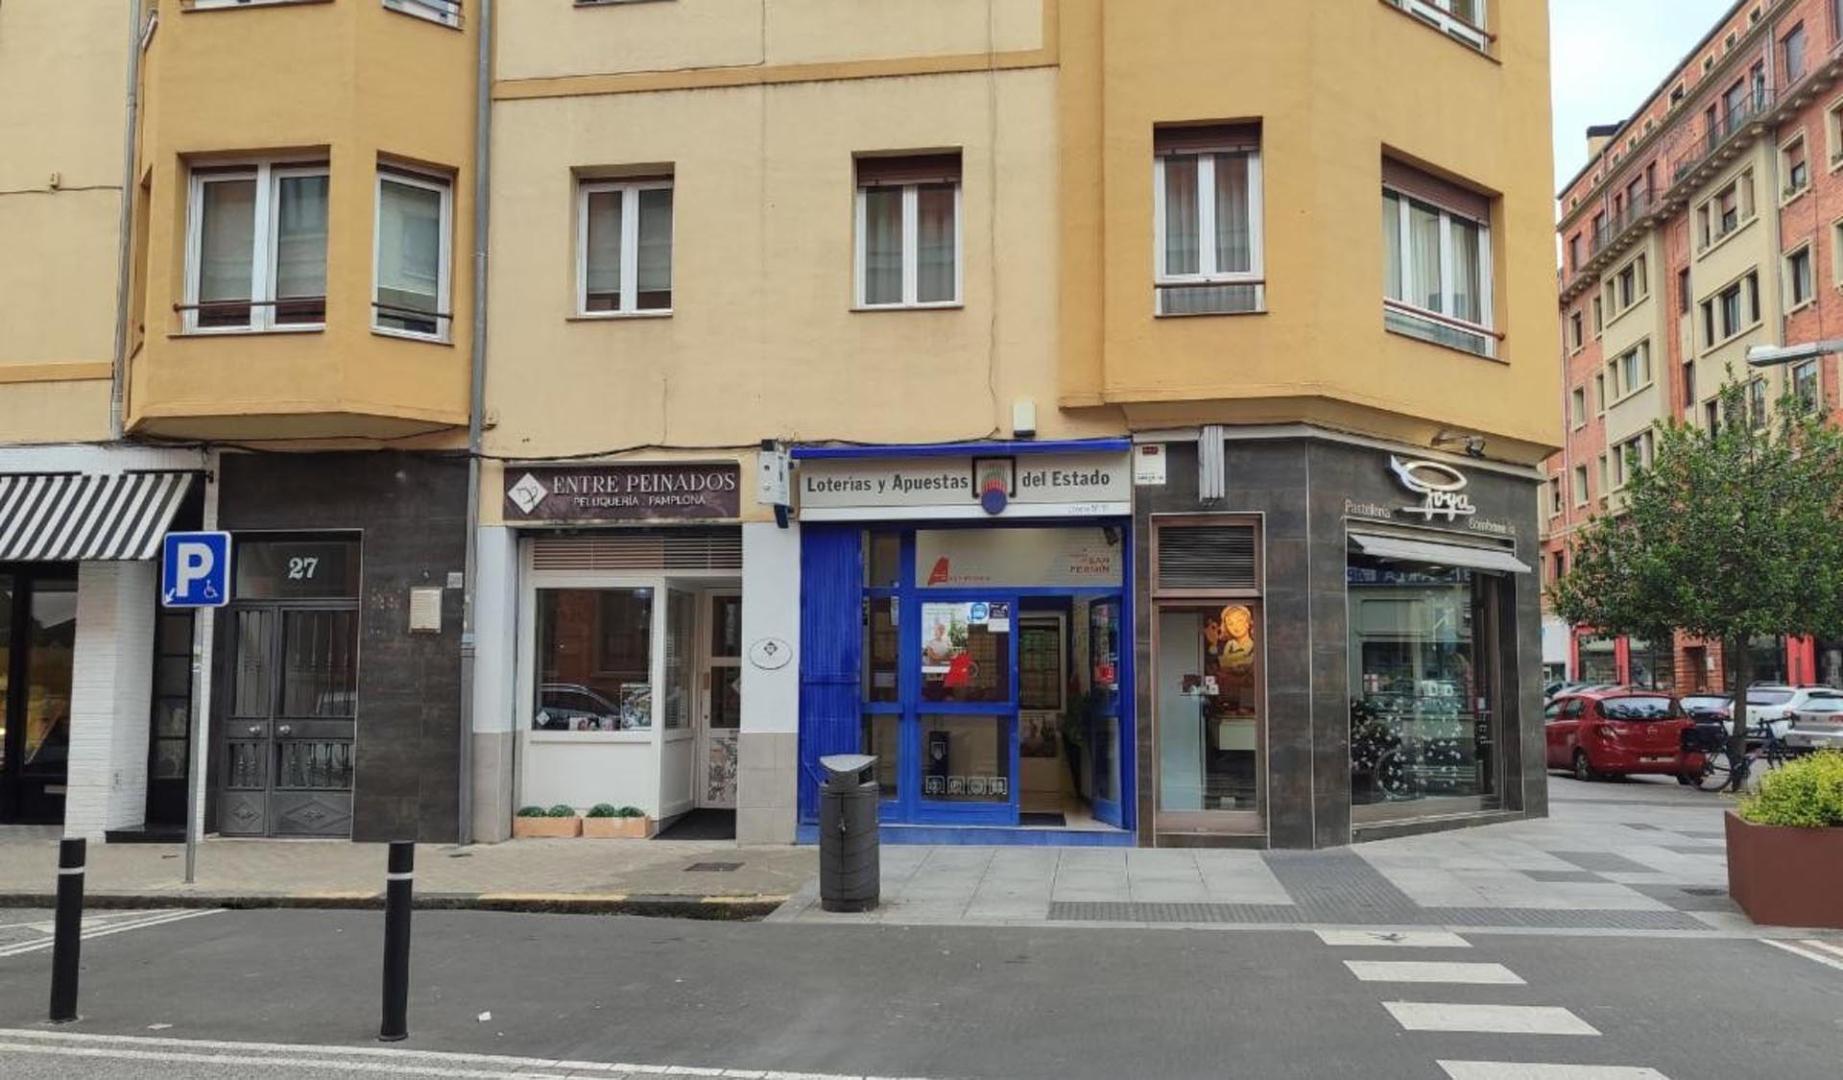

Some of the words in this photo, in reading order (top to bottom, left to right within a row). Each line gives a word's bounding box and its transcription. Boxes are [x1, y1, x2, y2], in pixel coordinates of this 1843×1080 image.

[552, 475, 620, 494] ENTRE
[626, 471, 737, 493] PEINADOS
[807, 474, 872, 493] Loterías
[878, 479, 886, 494] y
[892, 472, 969, 494] Apuestas
[1022, 470, 1047, 488] del
[1052, 469, 1111, 487] Estado
[648, 494, 706, 506] PAMPLONA
[176, 542, 214, 597] P
[288, 557, 319, 580] 27
